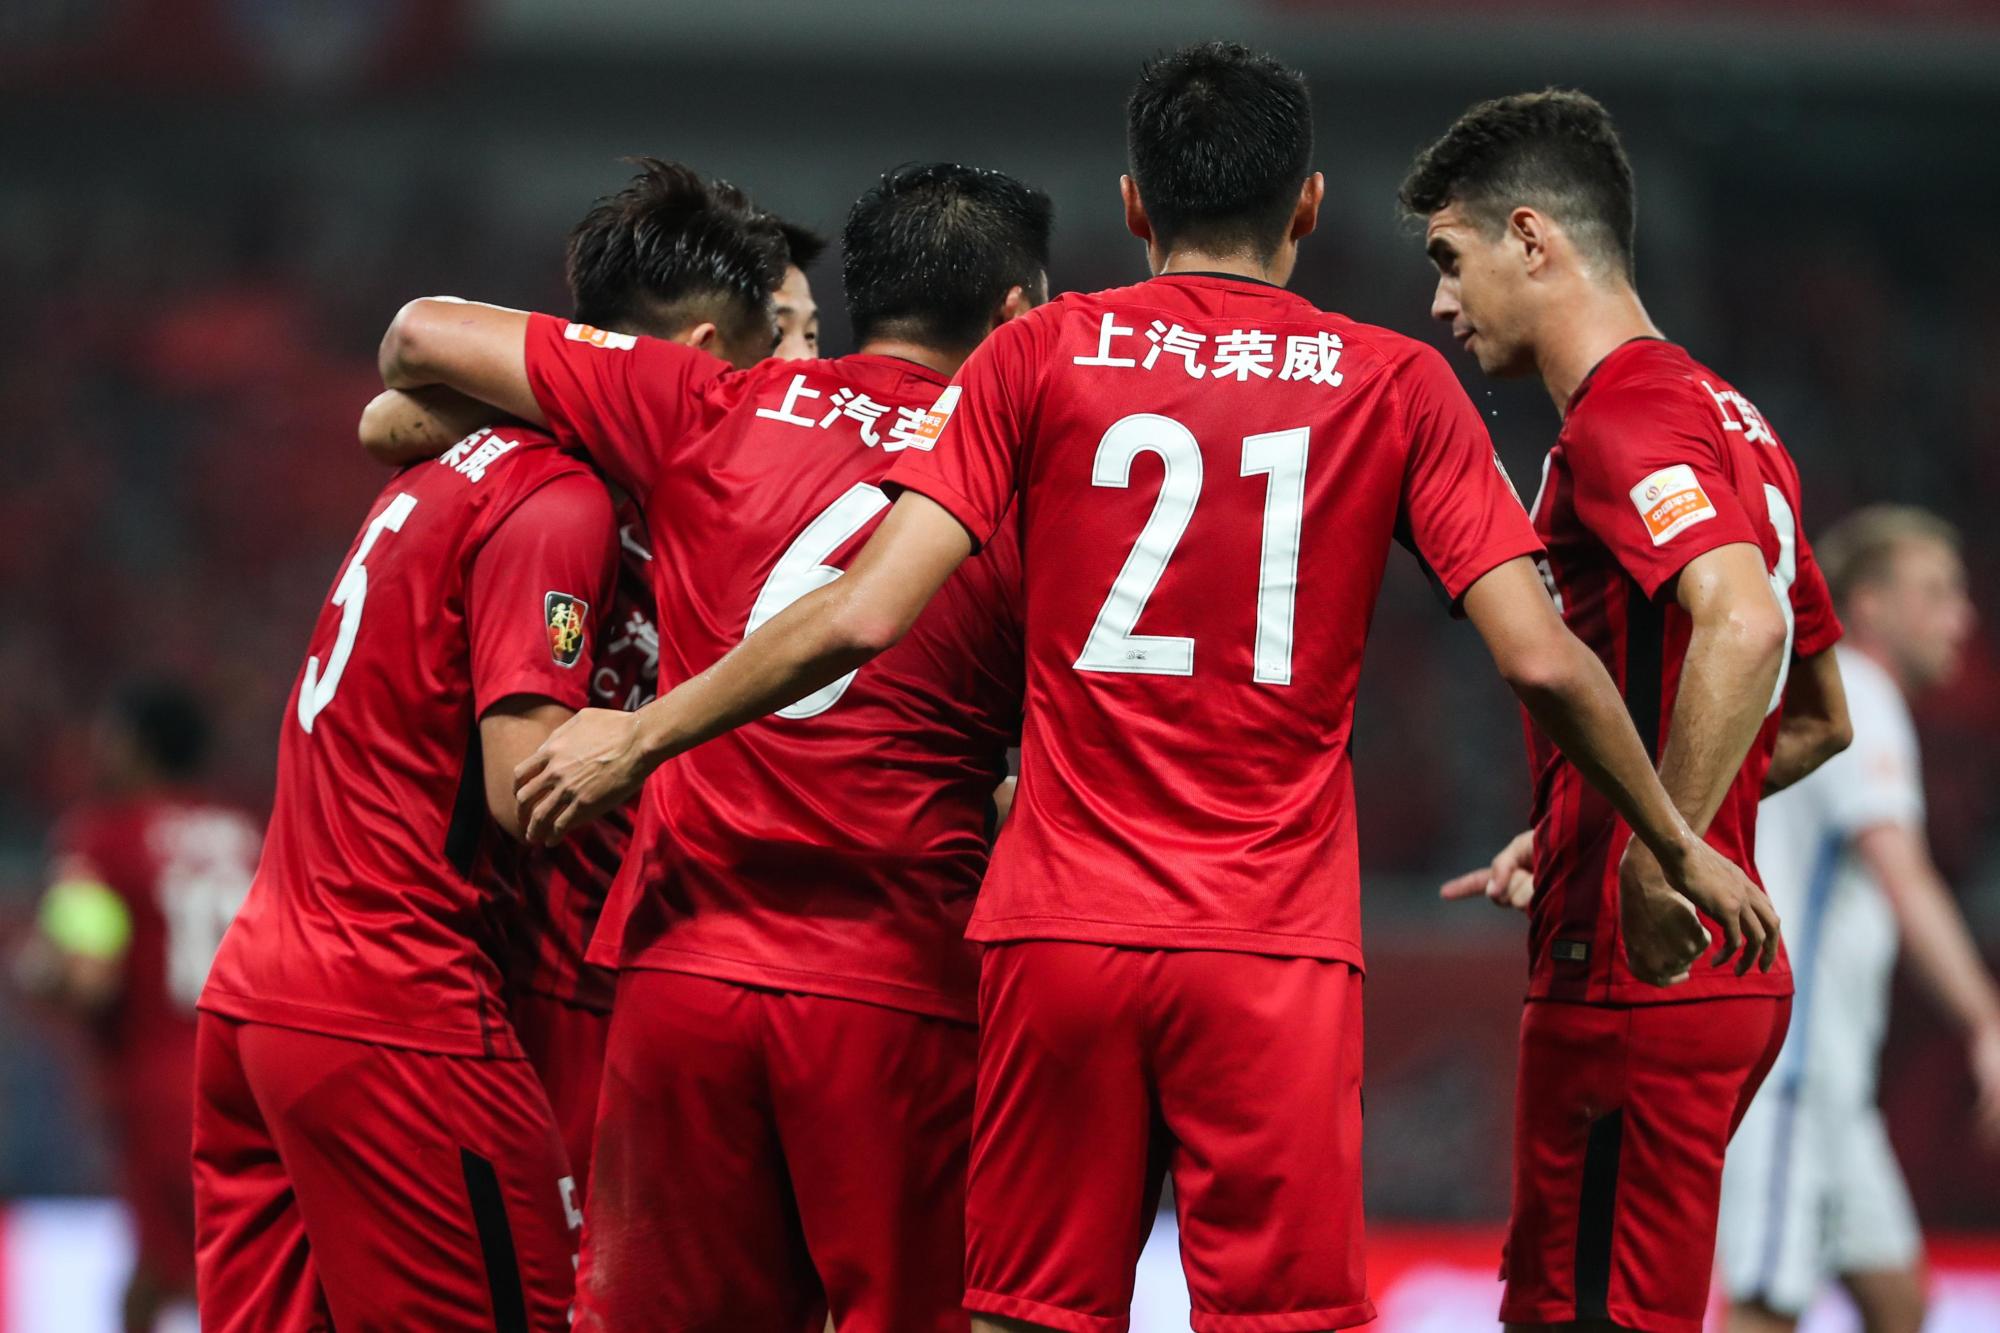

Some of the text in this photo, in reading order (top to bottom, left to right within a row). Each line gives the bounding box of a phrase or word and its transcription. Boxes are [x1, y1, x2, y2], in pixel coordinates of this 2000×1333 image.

[1073, 312, 1344, 388] 上汽荣威
[298, 492, 418, 735] 5
[1072, 413, 1311, 686] 21
